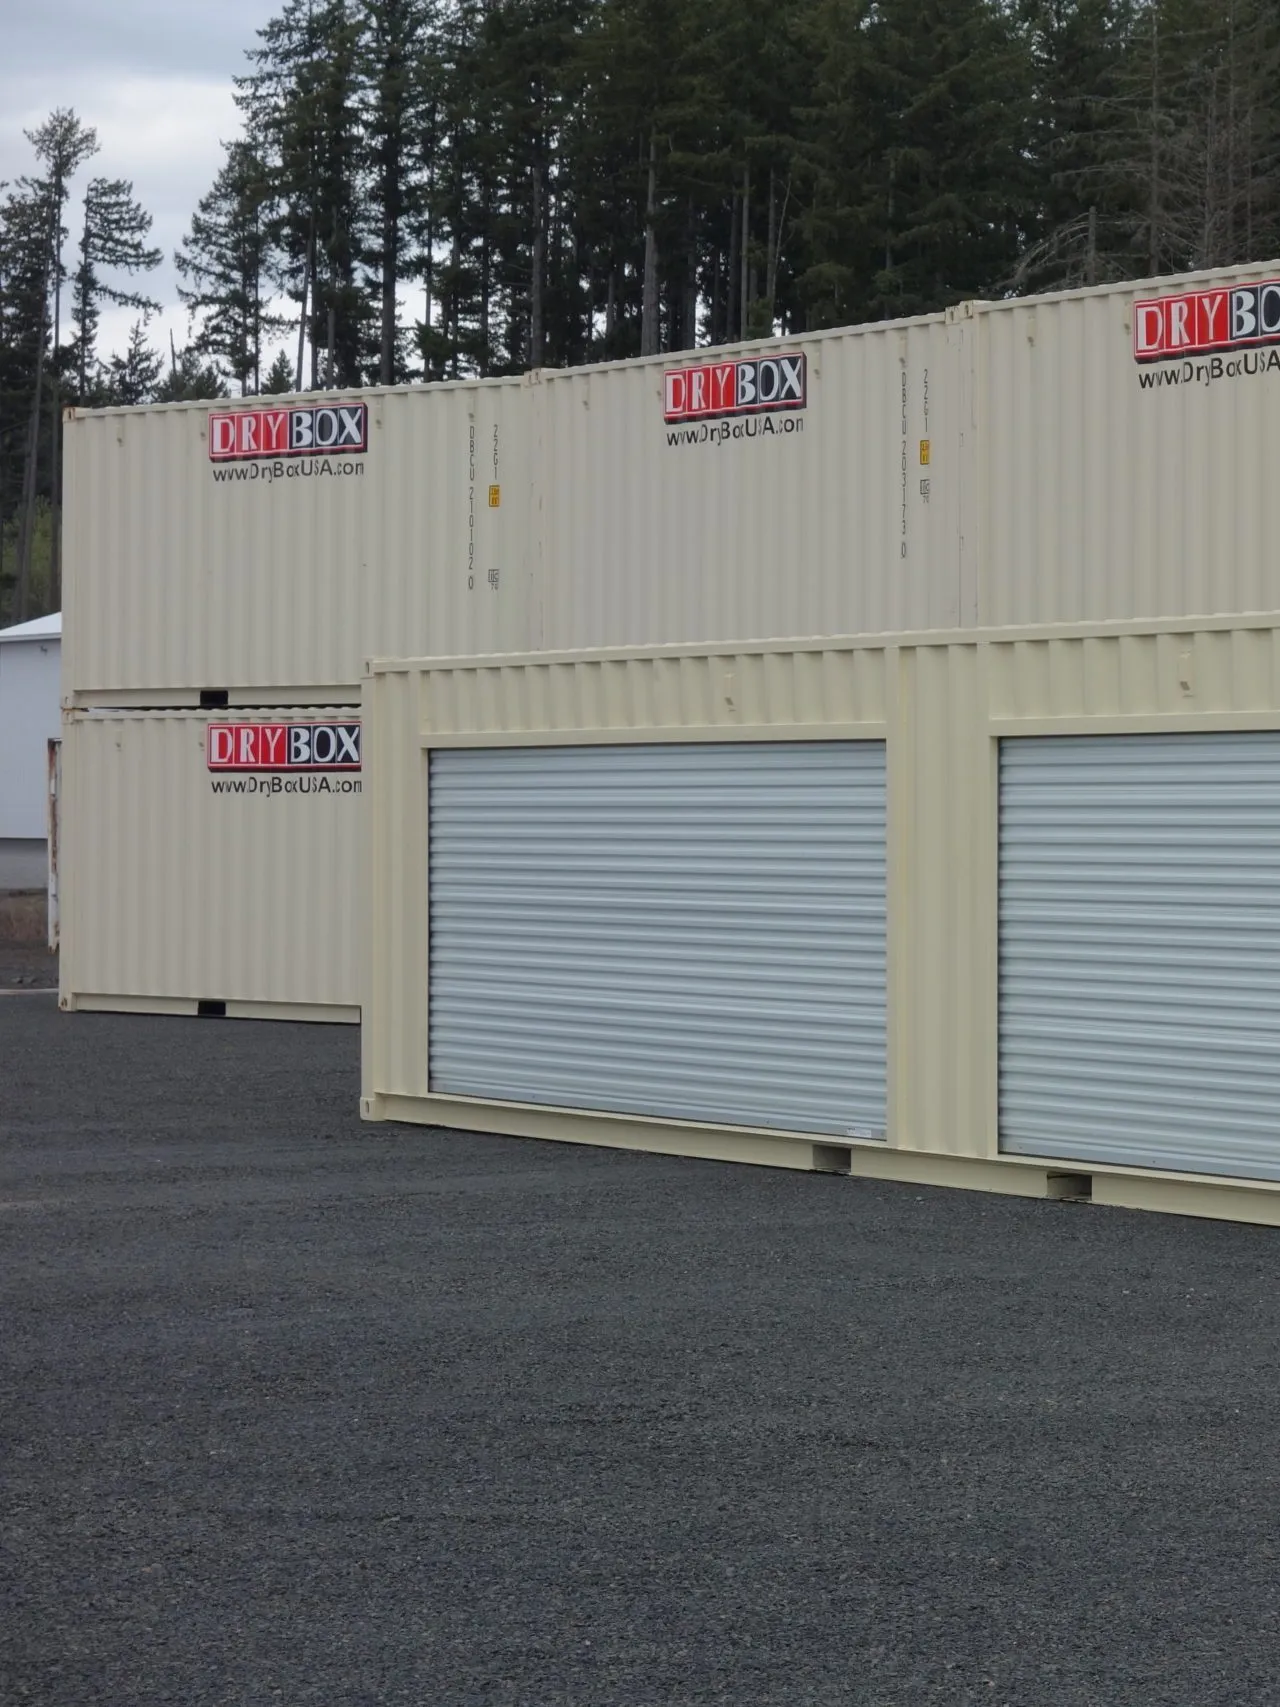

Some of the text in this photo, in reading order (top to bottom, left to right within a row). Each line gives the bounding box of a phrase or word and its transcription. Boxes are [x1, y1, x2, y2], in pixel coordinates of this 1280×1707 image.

[667, 416, 804, 446] www.DryBoxUSA.com
[213, 459, 364, 483] www.DryBoxUSA.com
[211, 776, 362, 798] www.DryBoxUSA.com
